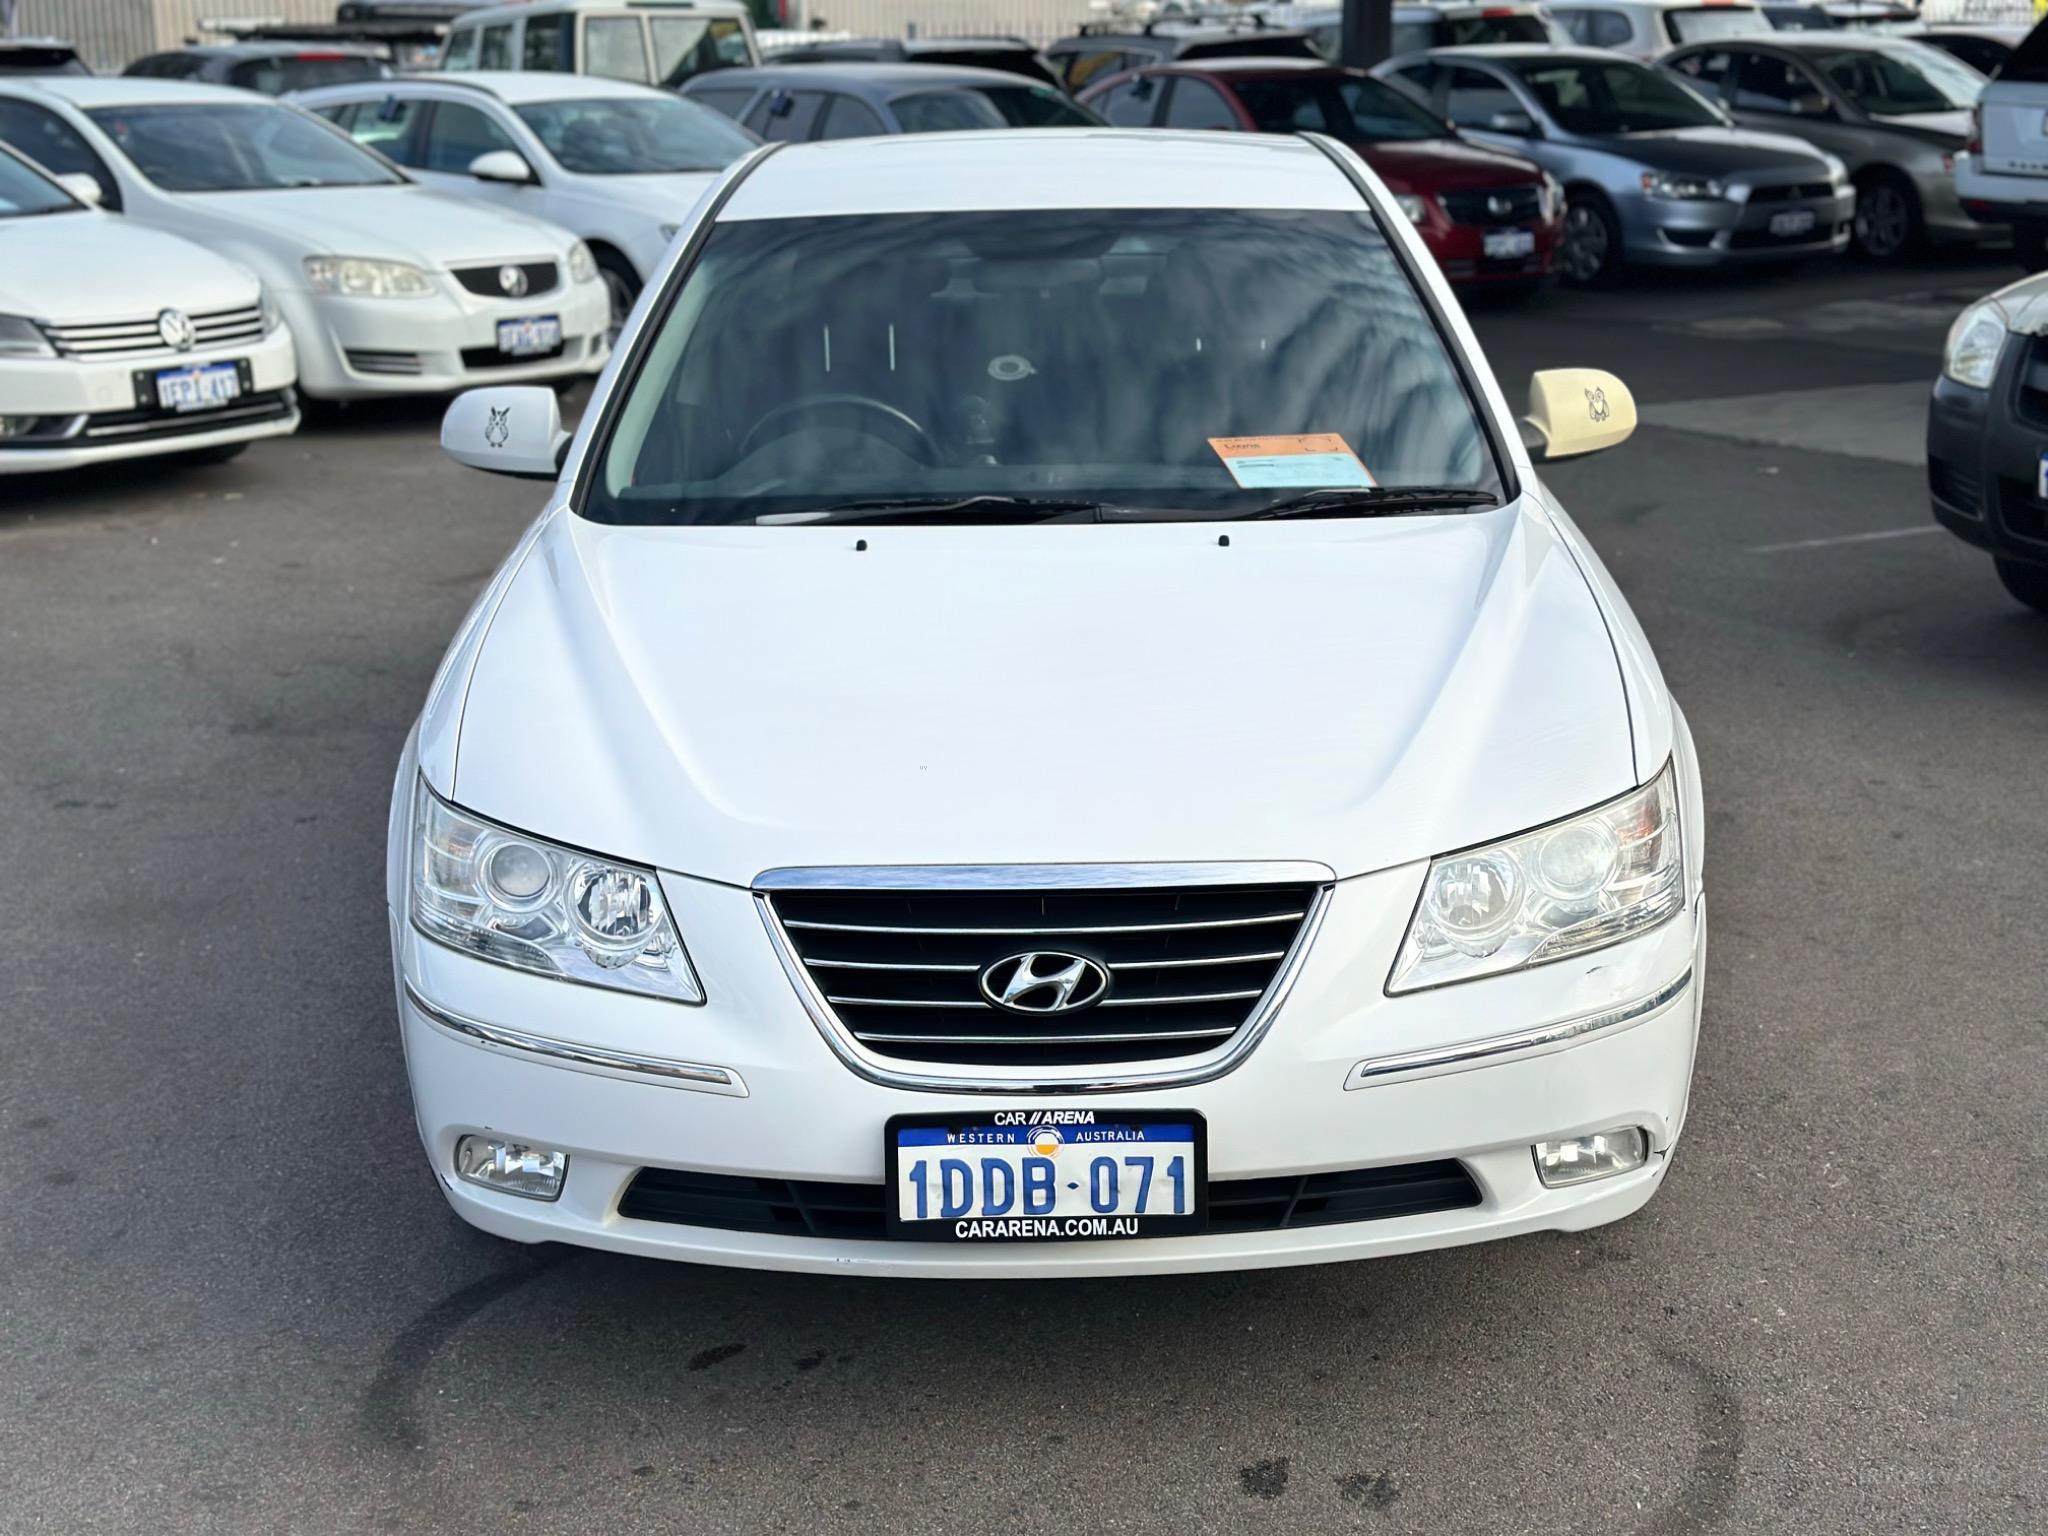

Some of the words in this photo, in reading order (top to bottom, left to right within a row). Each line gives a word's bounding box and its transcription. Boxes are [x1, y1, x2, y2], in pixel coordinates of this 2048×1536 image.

[994, 1112, 1026, 1126] CAR
[946, 1133, 1016, 1144] WESTERN
[1075, 1130, 1145, 1142] AUSTRALIA
[954, 1218, 1139, 1238] CARARENA.COM.AU
